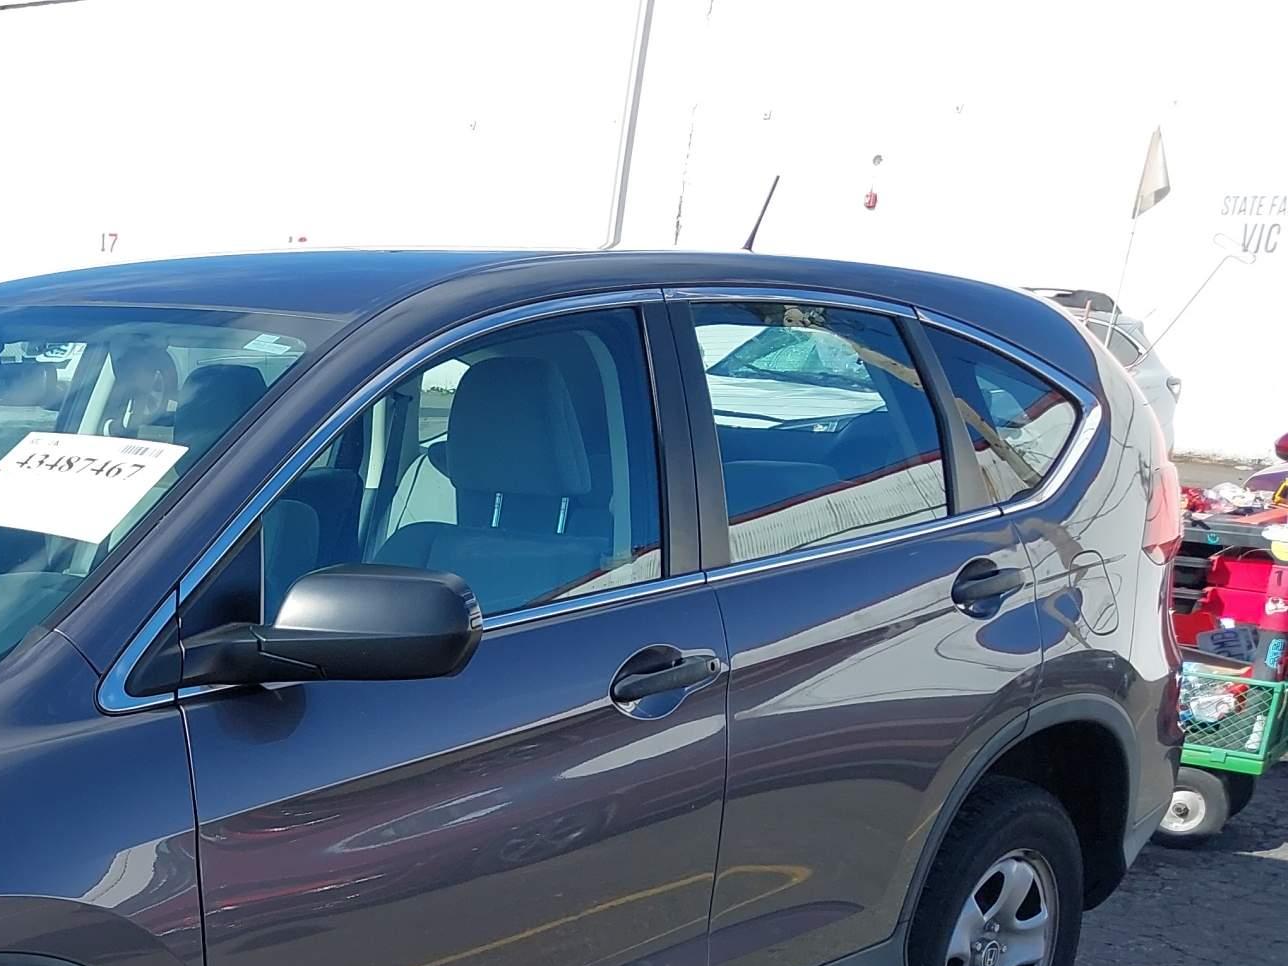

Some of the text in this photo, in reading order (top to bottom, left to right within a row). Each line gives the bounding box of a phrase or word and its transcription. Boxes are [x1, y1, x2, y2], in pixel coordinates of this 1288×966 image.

[1220, 195, 1267, 216] STATE
[100, 232, 119, 254] 17
[15, 452, 146, 481] 43487467
